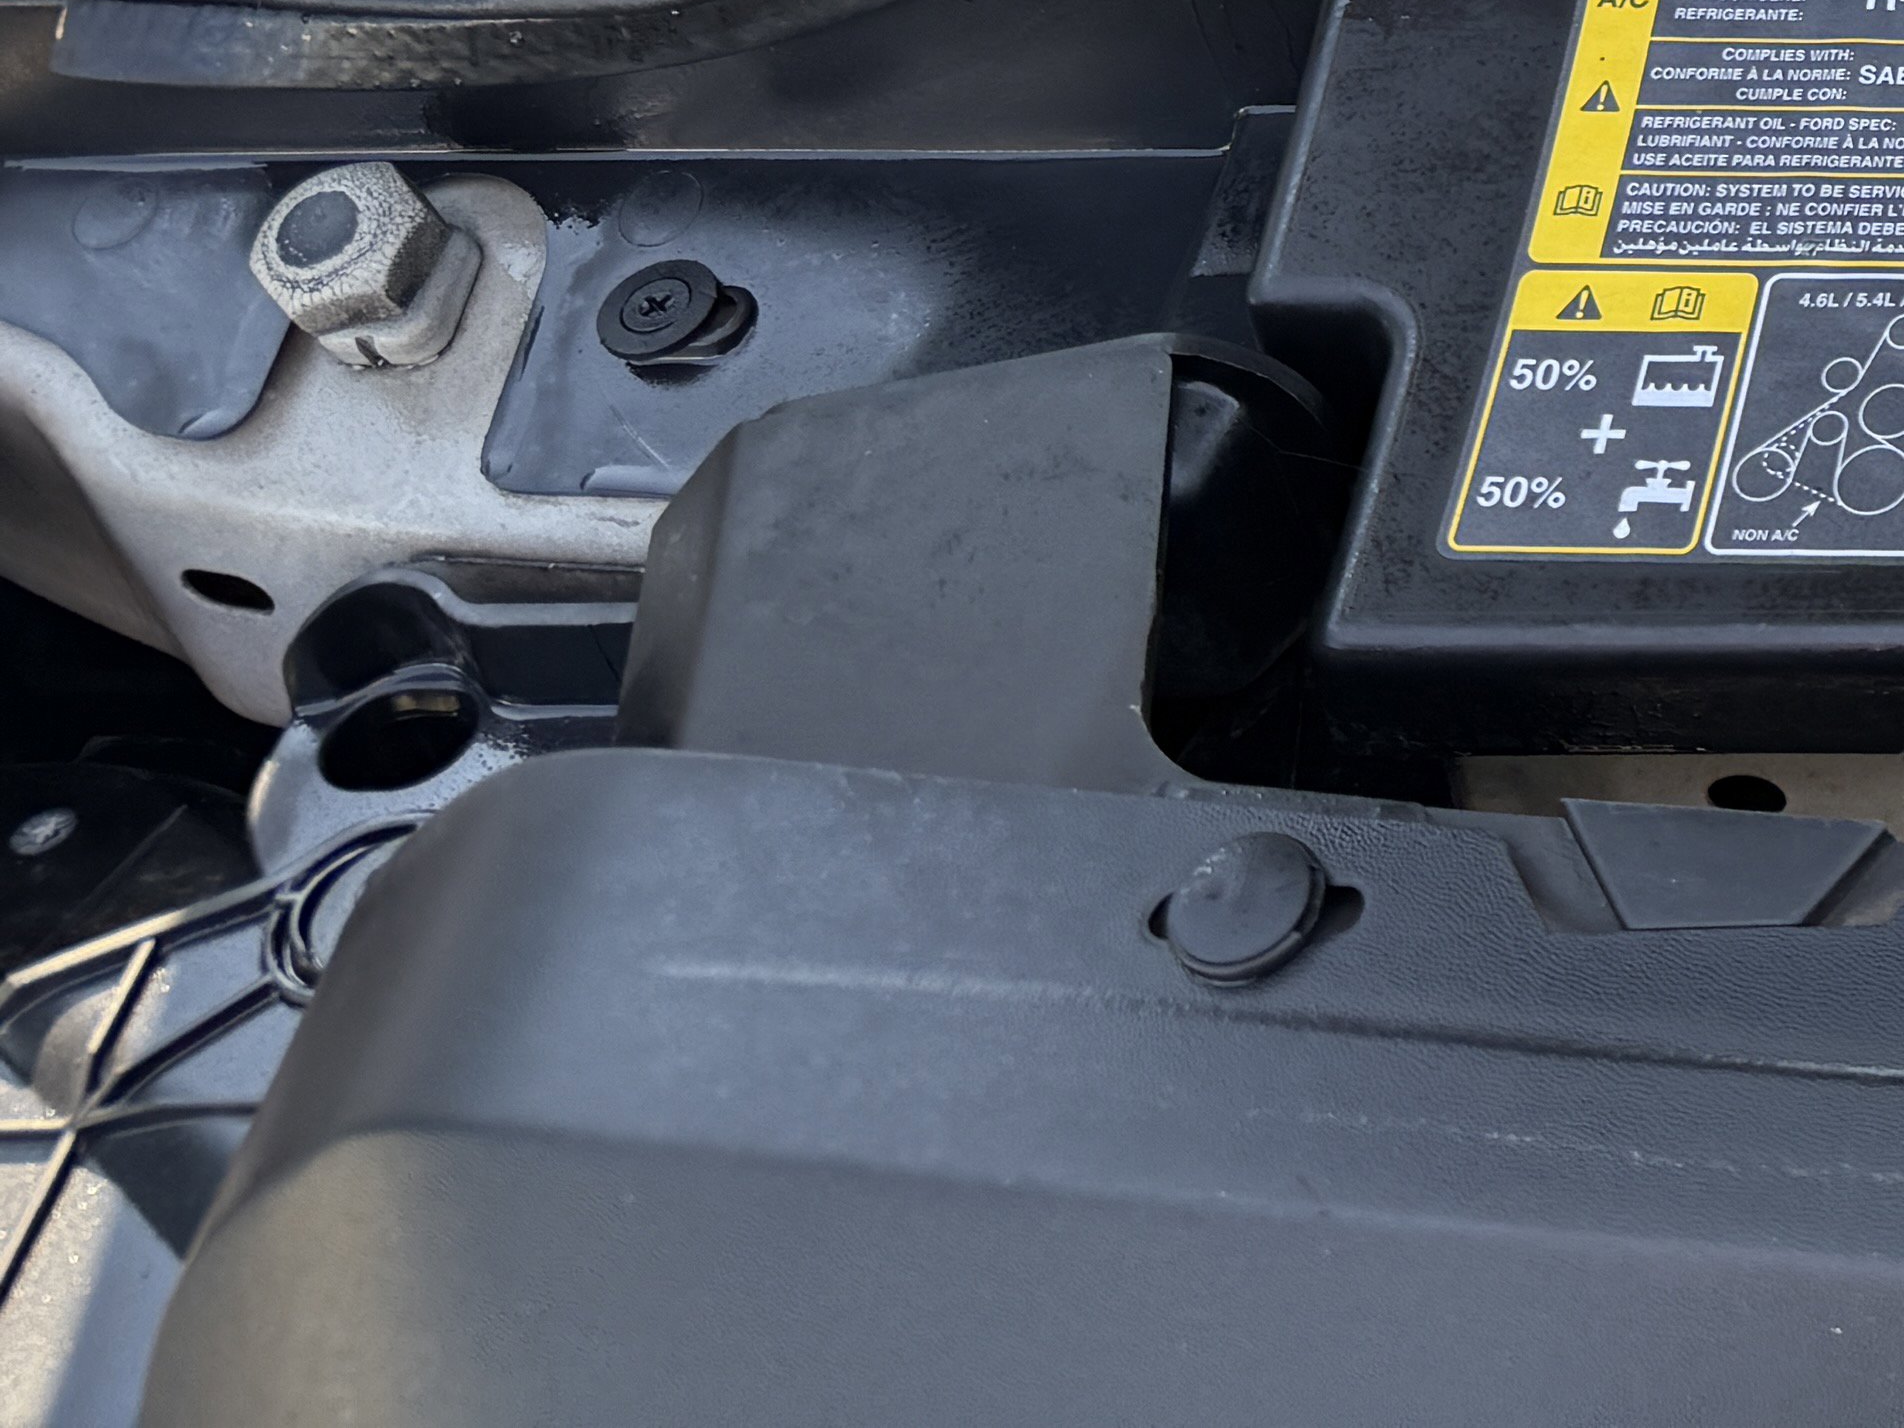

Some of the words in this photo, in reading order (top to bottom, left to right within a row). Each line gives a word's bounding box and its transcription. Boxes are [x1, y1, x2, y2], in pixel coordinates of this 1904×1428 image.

[1673, 6, 1804, 22] REFRIGERANTE:
[1721, 46, 1806, 62] COMPLIES
[1809, 48, 1855, 62] WITH:
[1734, 86, 1804, 101] CUMPLE
[1806, 87, 1848, 101] CON:
[1639, 115, 1758, 129] REFRIGERANT
[1758, 116, 1786, 130] OIL
[1798, 116, 1845, 131] FORD
[1847, 116, 1897, 132] SPEC:
[1625, 181, 1711, 197] CAUTION:
[1715, 182, 1788, 198] SYSTEM
[1791, 182, 1816, 198] TO
[1818, 183, 1846, 198] BE
[1615, 217, 1741, 235] PRECAUCIÓN:
[1748, 220, 1772, 235] EL
[1775, 220, 1853, 235] SISTEMA
[1798, 292, 1840, 308] 4.6L
[1854, 291, 1896, 308] 5.4L
[1508, 358, 1597, 391] 50%
[1475, 475, 1566, 509] 50%
[1731, 528, 1770, 542] NON
[1770, 528, 1800, 542] A/C
